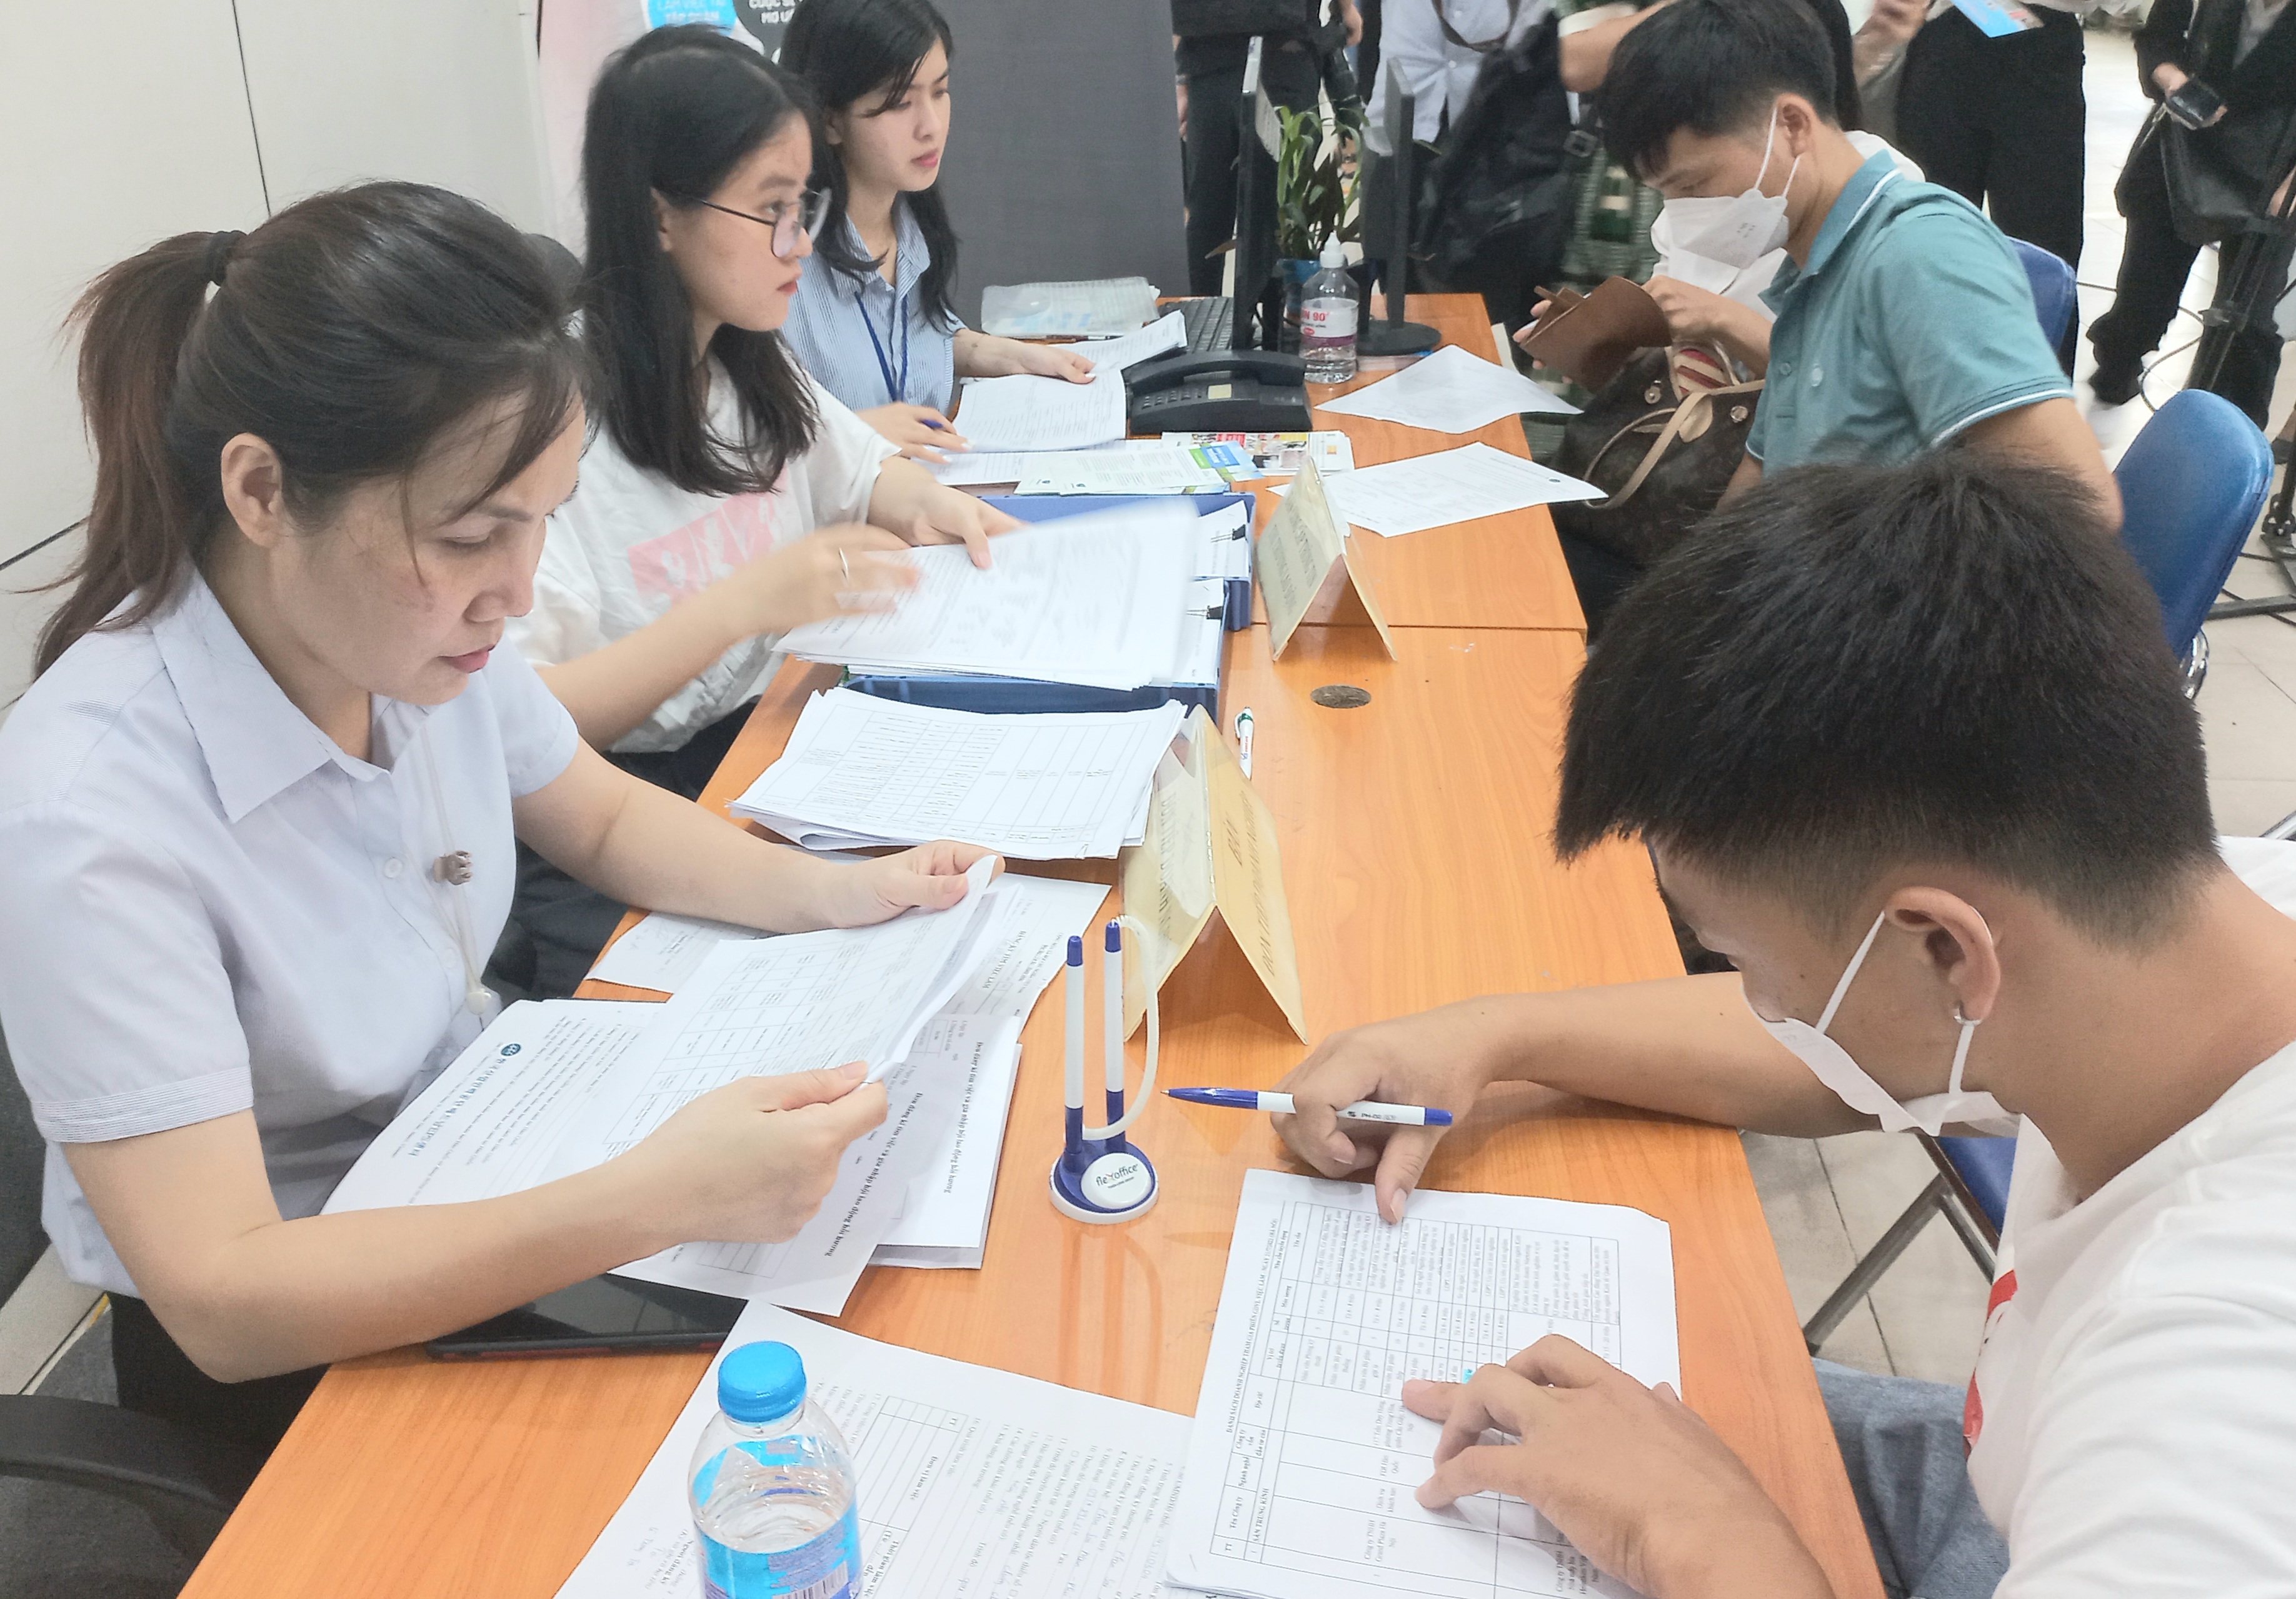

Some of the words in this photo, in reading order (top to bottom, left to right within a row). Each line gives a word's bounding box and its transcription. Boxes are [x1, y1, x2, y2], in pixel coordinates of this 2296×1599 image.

[1096, 1164, 1138, 1186] flexoffice
[1258, 1487, 1269, 1504] KÍNH
[1254, 1505, 1266, 1528] TRUNG
